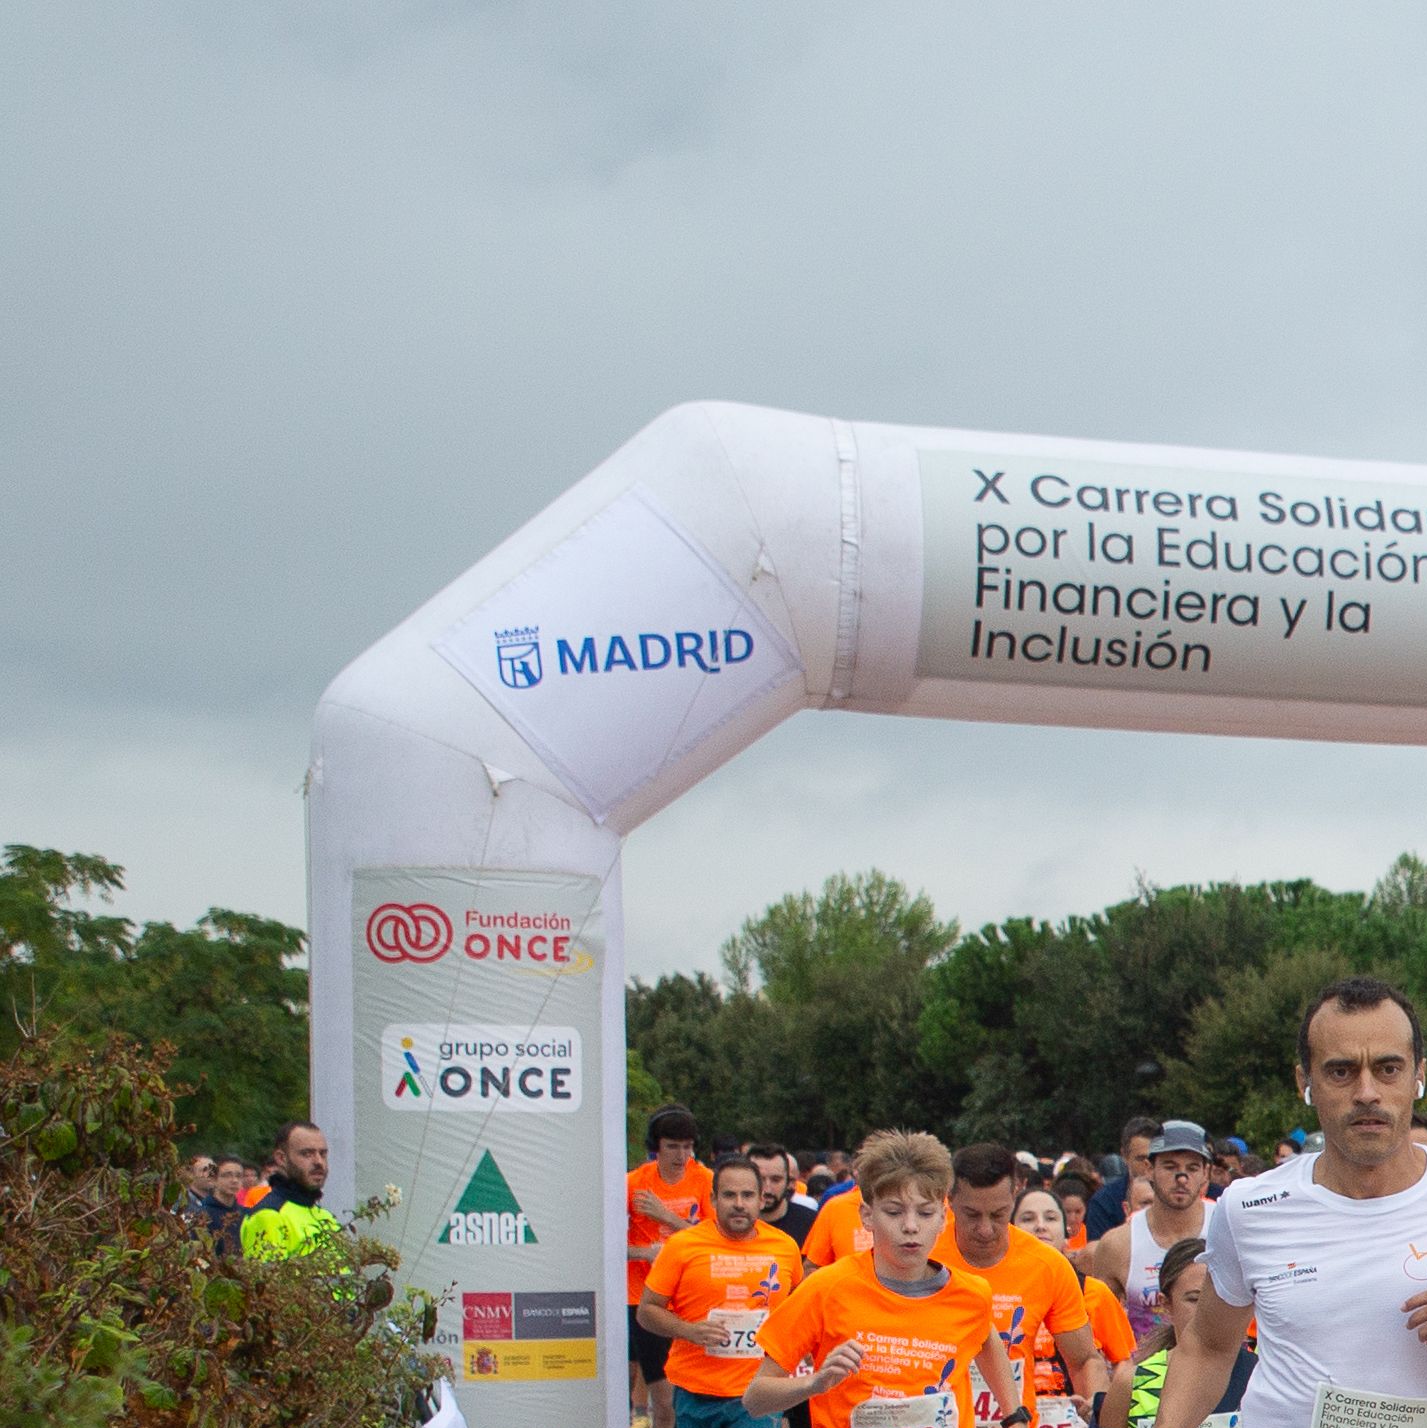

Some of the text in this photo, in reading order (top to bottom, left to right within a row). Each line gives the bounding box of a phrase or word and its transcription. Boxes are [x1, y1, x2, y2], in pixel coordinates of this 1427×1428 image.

[973, 469, 1009, 504] X
[1030, 475, 1239, 521] Carrera
[976, 523, 1068, 564] por
[1088, 522, 1134, 564] la
[975, 566, 1370, 639] Financiera y la
[556, 629, 754, 675] MADRID
[970, 619, 1212, 672] Inclusión
[465, 910, 570, 930] Fundación
[464, 934, 571, 962] ONCE
[439, 1040, 572, 1060] grupo social
[440, 1066, 572, 1099] ONCE
[450, 1212, 529, 1245] asnef
[462, 1303, 512, 1319] CNMV
[861, 1343, 873, 1351] or
[867, 1333, 909, 1345] Carrera
[912, 1338, 957, 1353] Solidaria
[1323, 1402, 1414, 1424] por la Educación
[1325, 1391, 1426, 1414] X Carrera Solidaria
